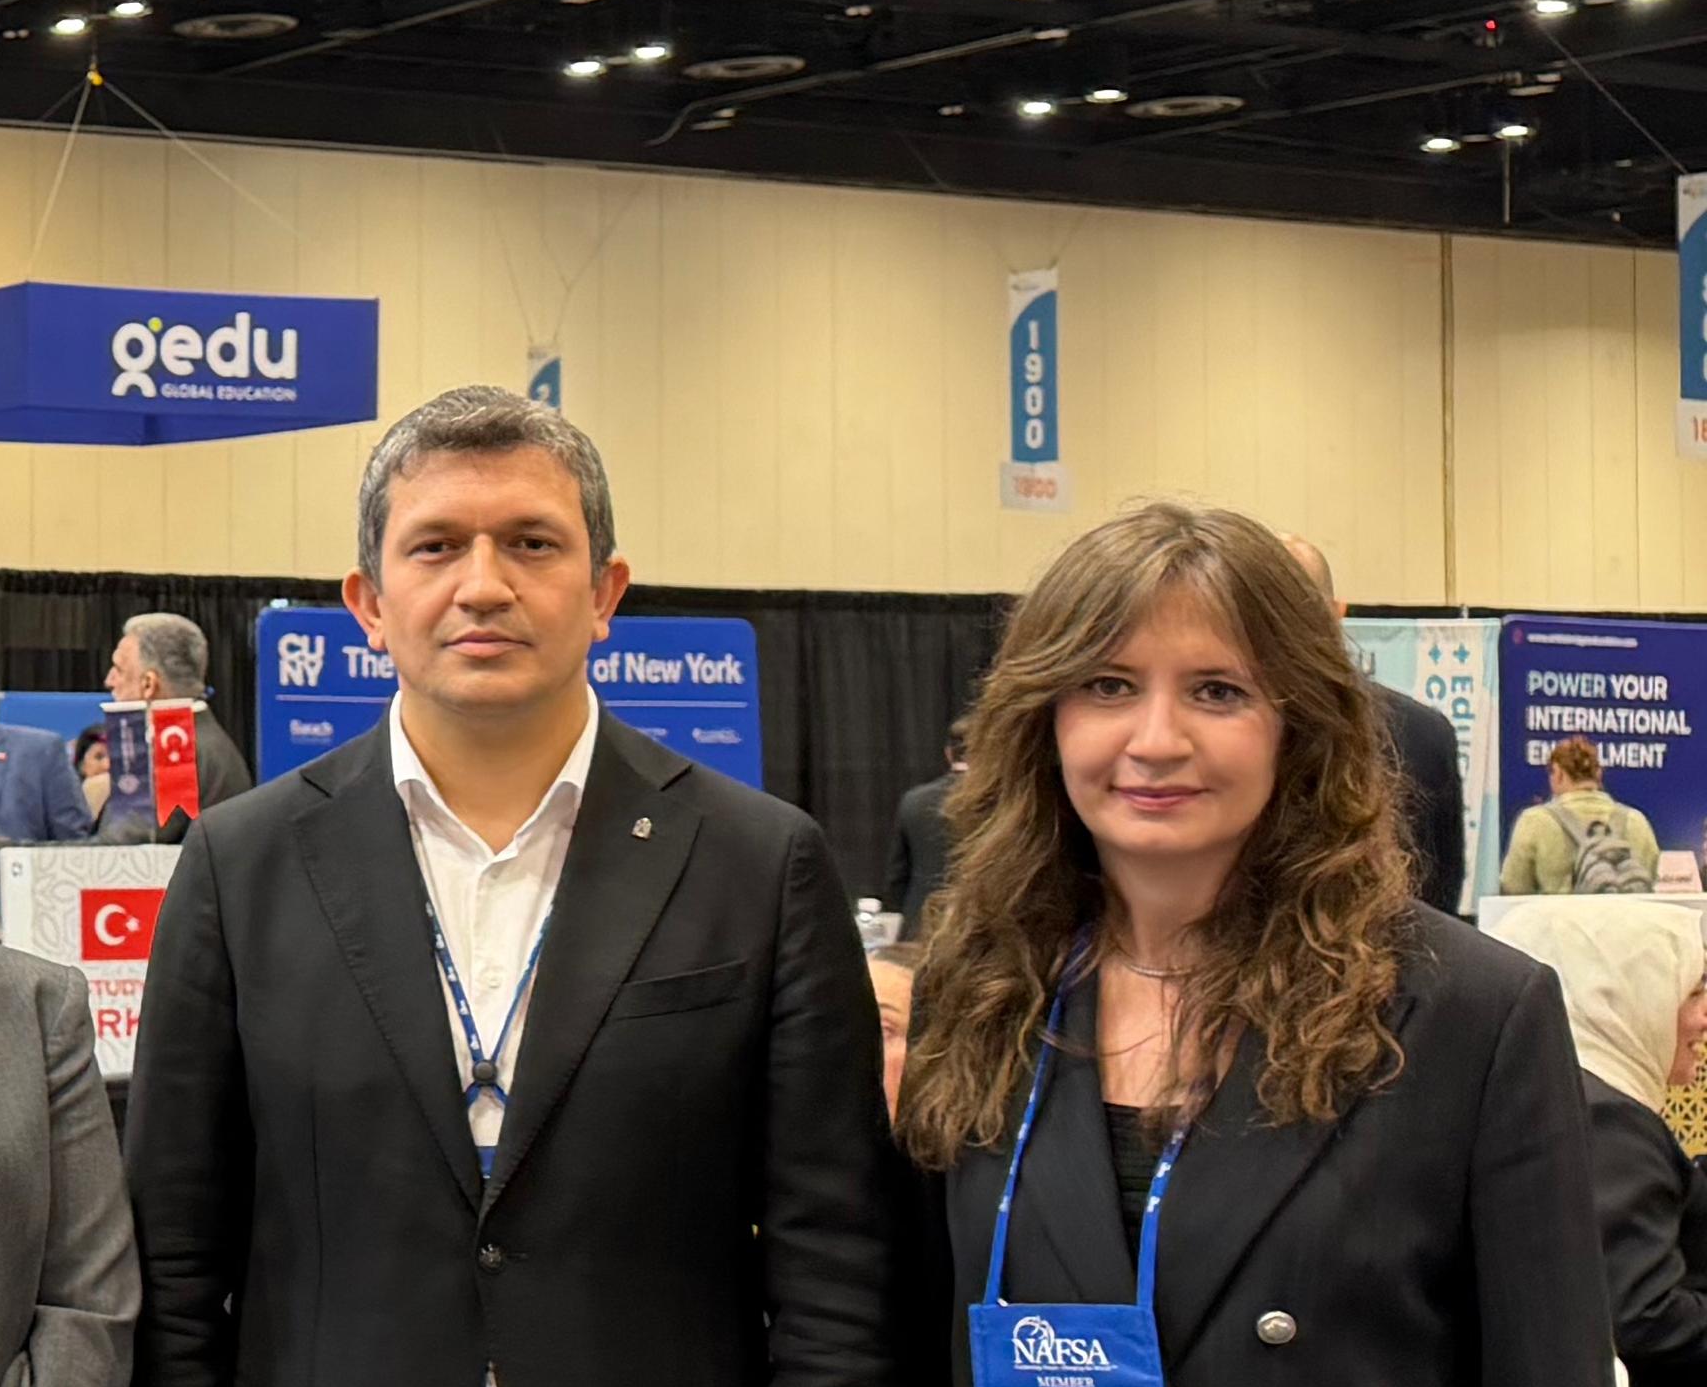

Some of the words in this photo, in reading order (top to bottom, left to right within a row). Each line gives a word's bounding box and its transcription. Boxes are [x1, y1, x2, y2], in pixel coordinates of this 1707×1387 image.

[111, 312, 298, 398] gedu
[161, 383, 214, 399] GLOBAL
[216, 385, 297, 401] EDUCATION
[1025, 320, 1044, 450] 1900
[342, 646, 395, 679] The
[593, 652, 621, 683] of
[624, 652, 683, 684] New
[685, 652, 745, 685] York
[1527, 670, 1608, 699] POWER
[1610, 674, 1668, 701] YOUR
[1526, 705, 1692, 736] INTERNATIONAL
[1526, 739, 1667, 769] ENLMENT
[1012, 1338, 1110, 1364] NAFSA
